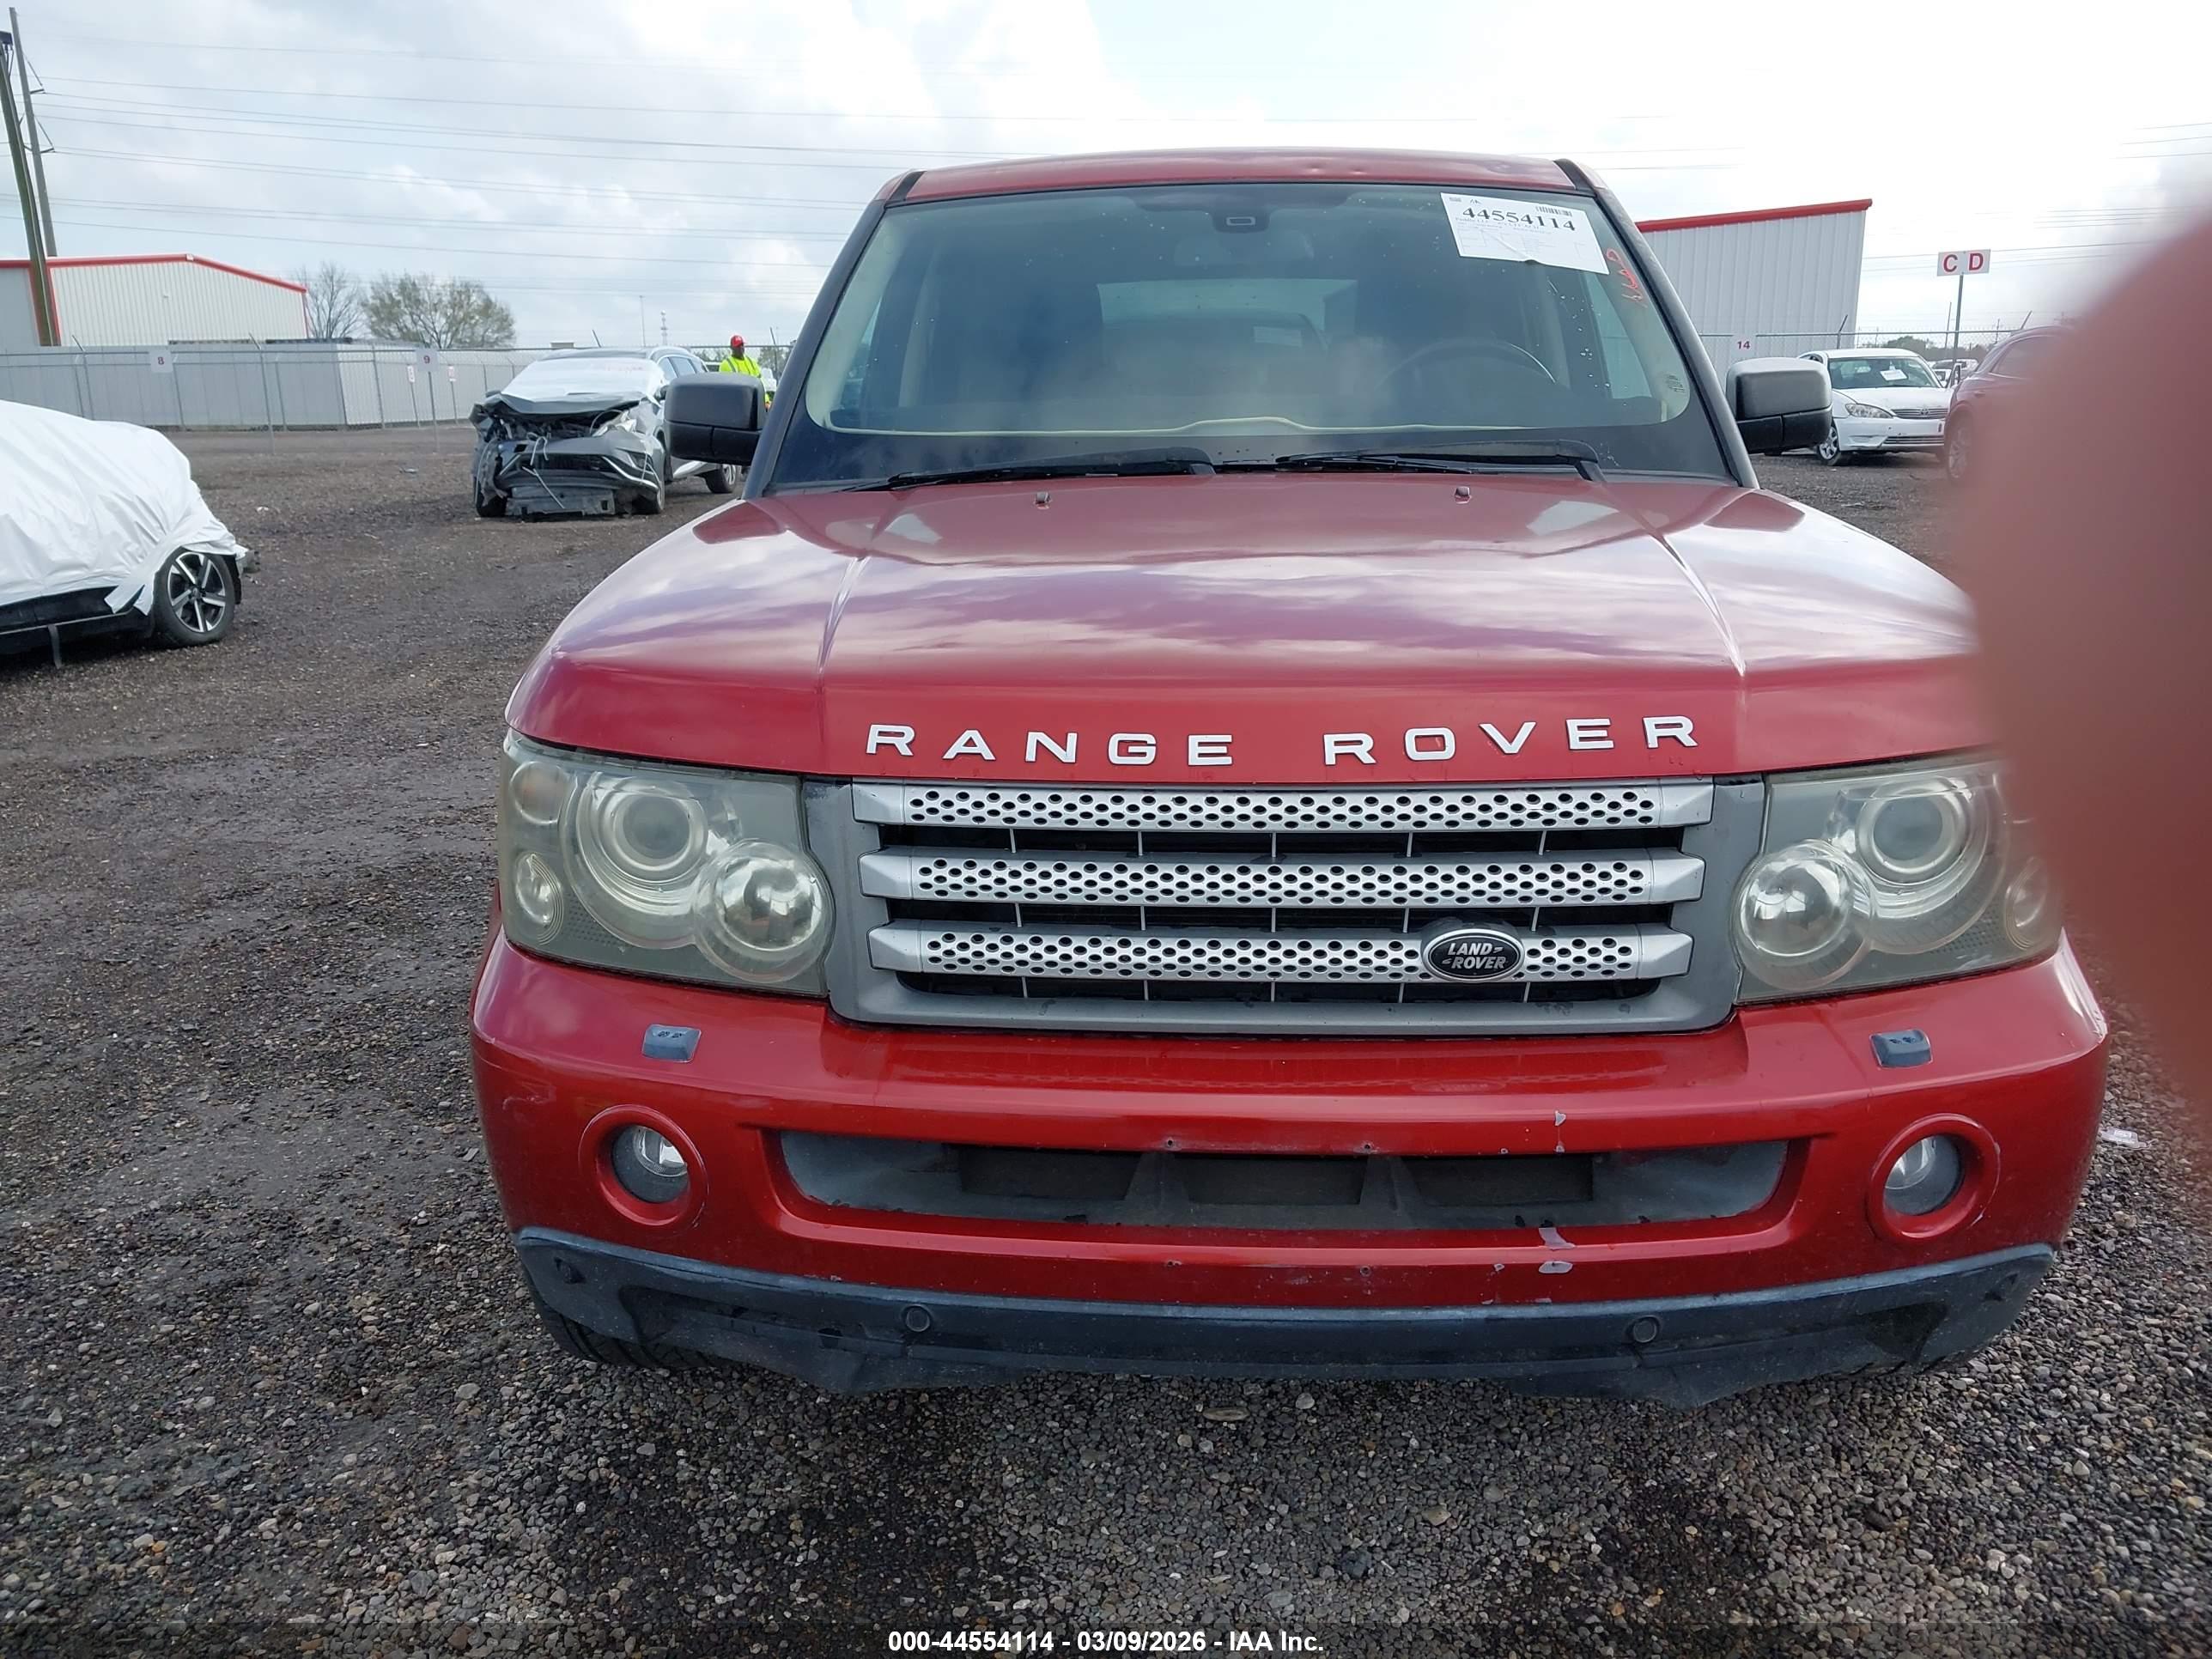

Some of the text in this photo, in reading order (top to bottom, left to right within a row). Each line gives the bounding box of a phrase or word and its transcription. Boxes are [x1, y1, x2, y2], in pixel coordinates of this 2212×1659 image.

[1462, 207, 1576, 231] 44554114
[1943, 252, 1984, 272] C D
[1737, 340, 1751, 349] 14
[157, 356, 165, 365] 8
[423, 355, 430, 364] 9
[866, 715, 1699, 766] RANGE ROVER
[1447, 943, 1492, 956] LAND
[1451, 956, 1506, 969] ROVER
